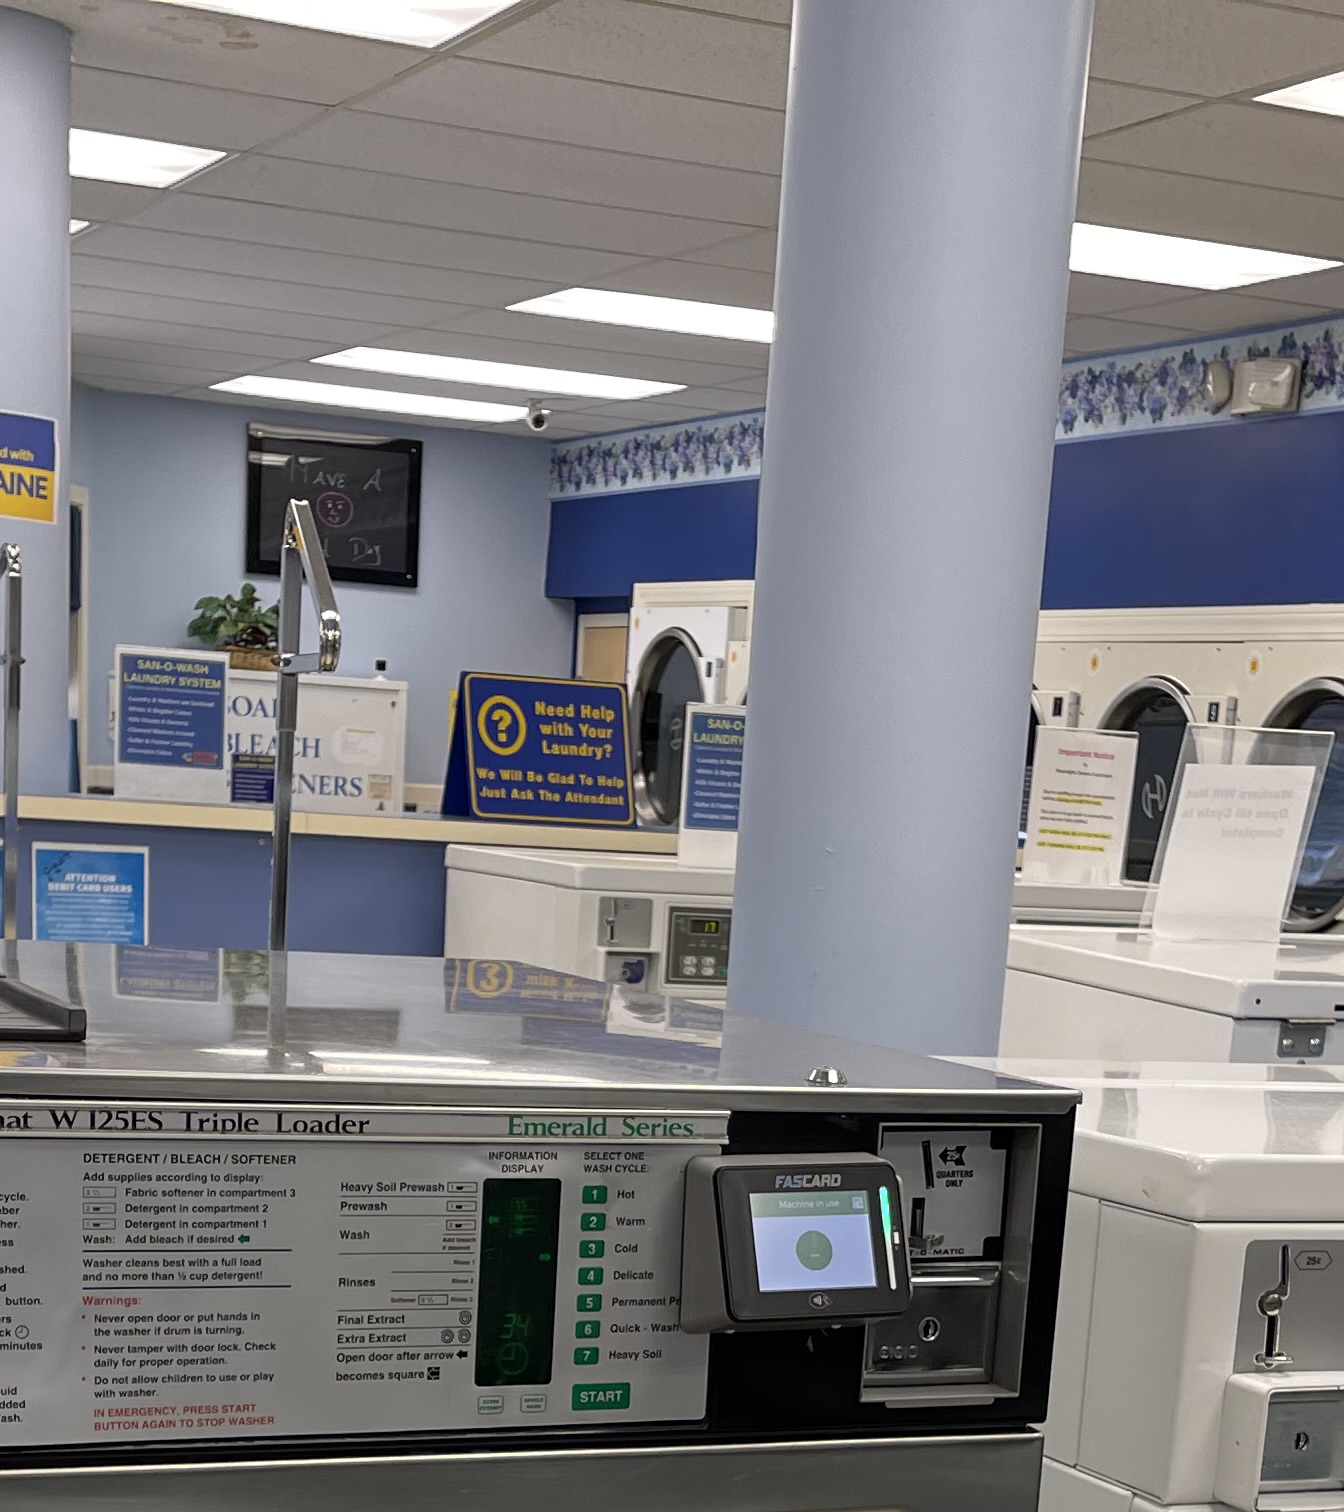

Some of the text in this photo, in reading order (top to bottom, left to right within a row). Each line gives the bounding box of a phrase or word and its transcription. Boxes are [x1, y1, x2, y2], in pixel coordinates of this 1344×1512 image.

[9, 446, 35, 462] with
[363, 468, 383, 491] A
[137, 659, 209, 675] SAN-O-WASH
[124, 673, 221, 690] LAUNDRY SYSTEM
[535, 701, 615, 722] Need Help
[539, 722, 613, 740] with Your
[542, 739, 613, 760] Laundry?
[476, 767, 624, 788] We Will Be Glad To Help
[480, 786, 624, 806] Just Ask The Attendant
[50, 1109, 79, 1130] W
[180, 1110, 259, 1134] Triple
[275, 1113, 370, 1136] Loader
[508, 1116, 608, 1138] Emerald
[623, 1117, 694, 1138] Series
[83, 1153, 297, 1165] DETERGENT BLEACH SOFTENER
[775, 1173, 841, 1188] FASCARD
[580, 1391, 623, 1403] START
[94, 1409, 104, 1417] IN
[183, 1405, 219, 1415] PRESS
[221, 1404, 256, 1413] START
[94, 1416, 275, 1431] BUTTON AGAIN TO STOP WASHER
